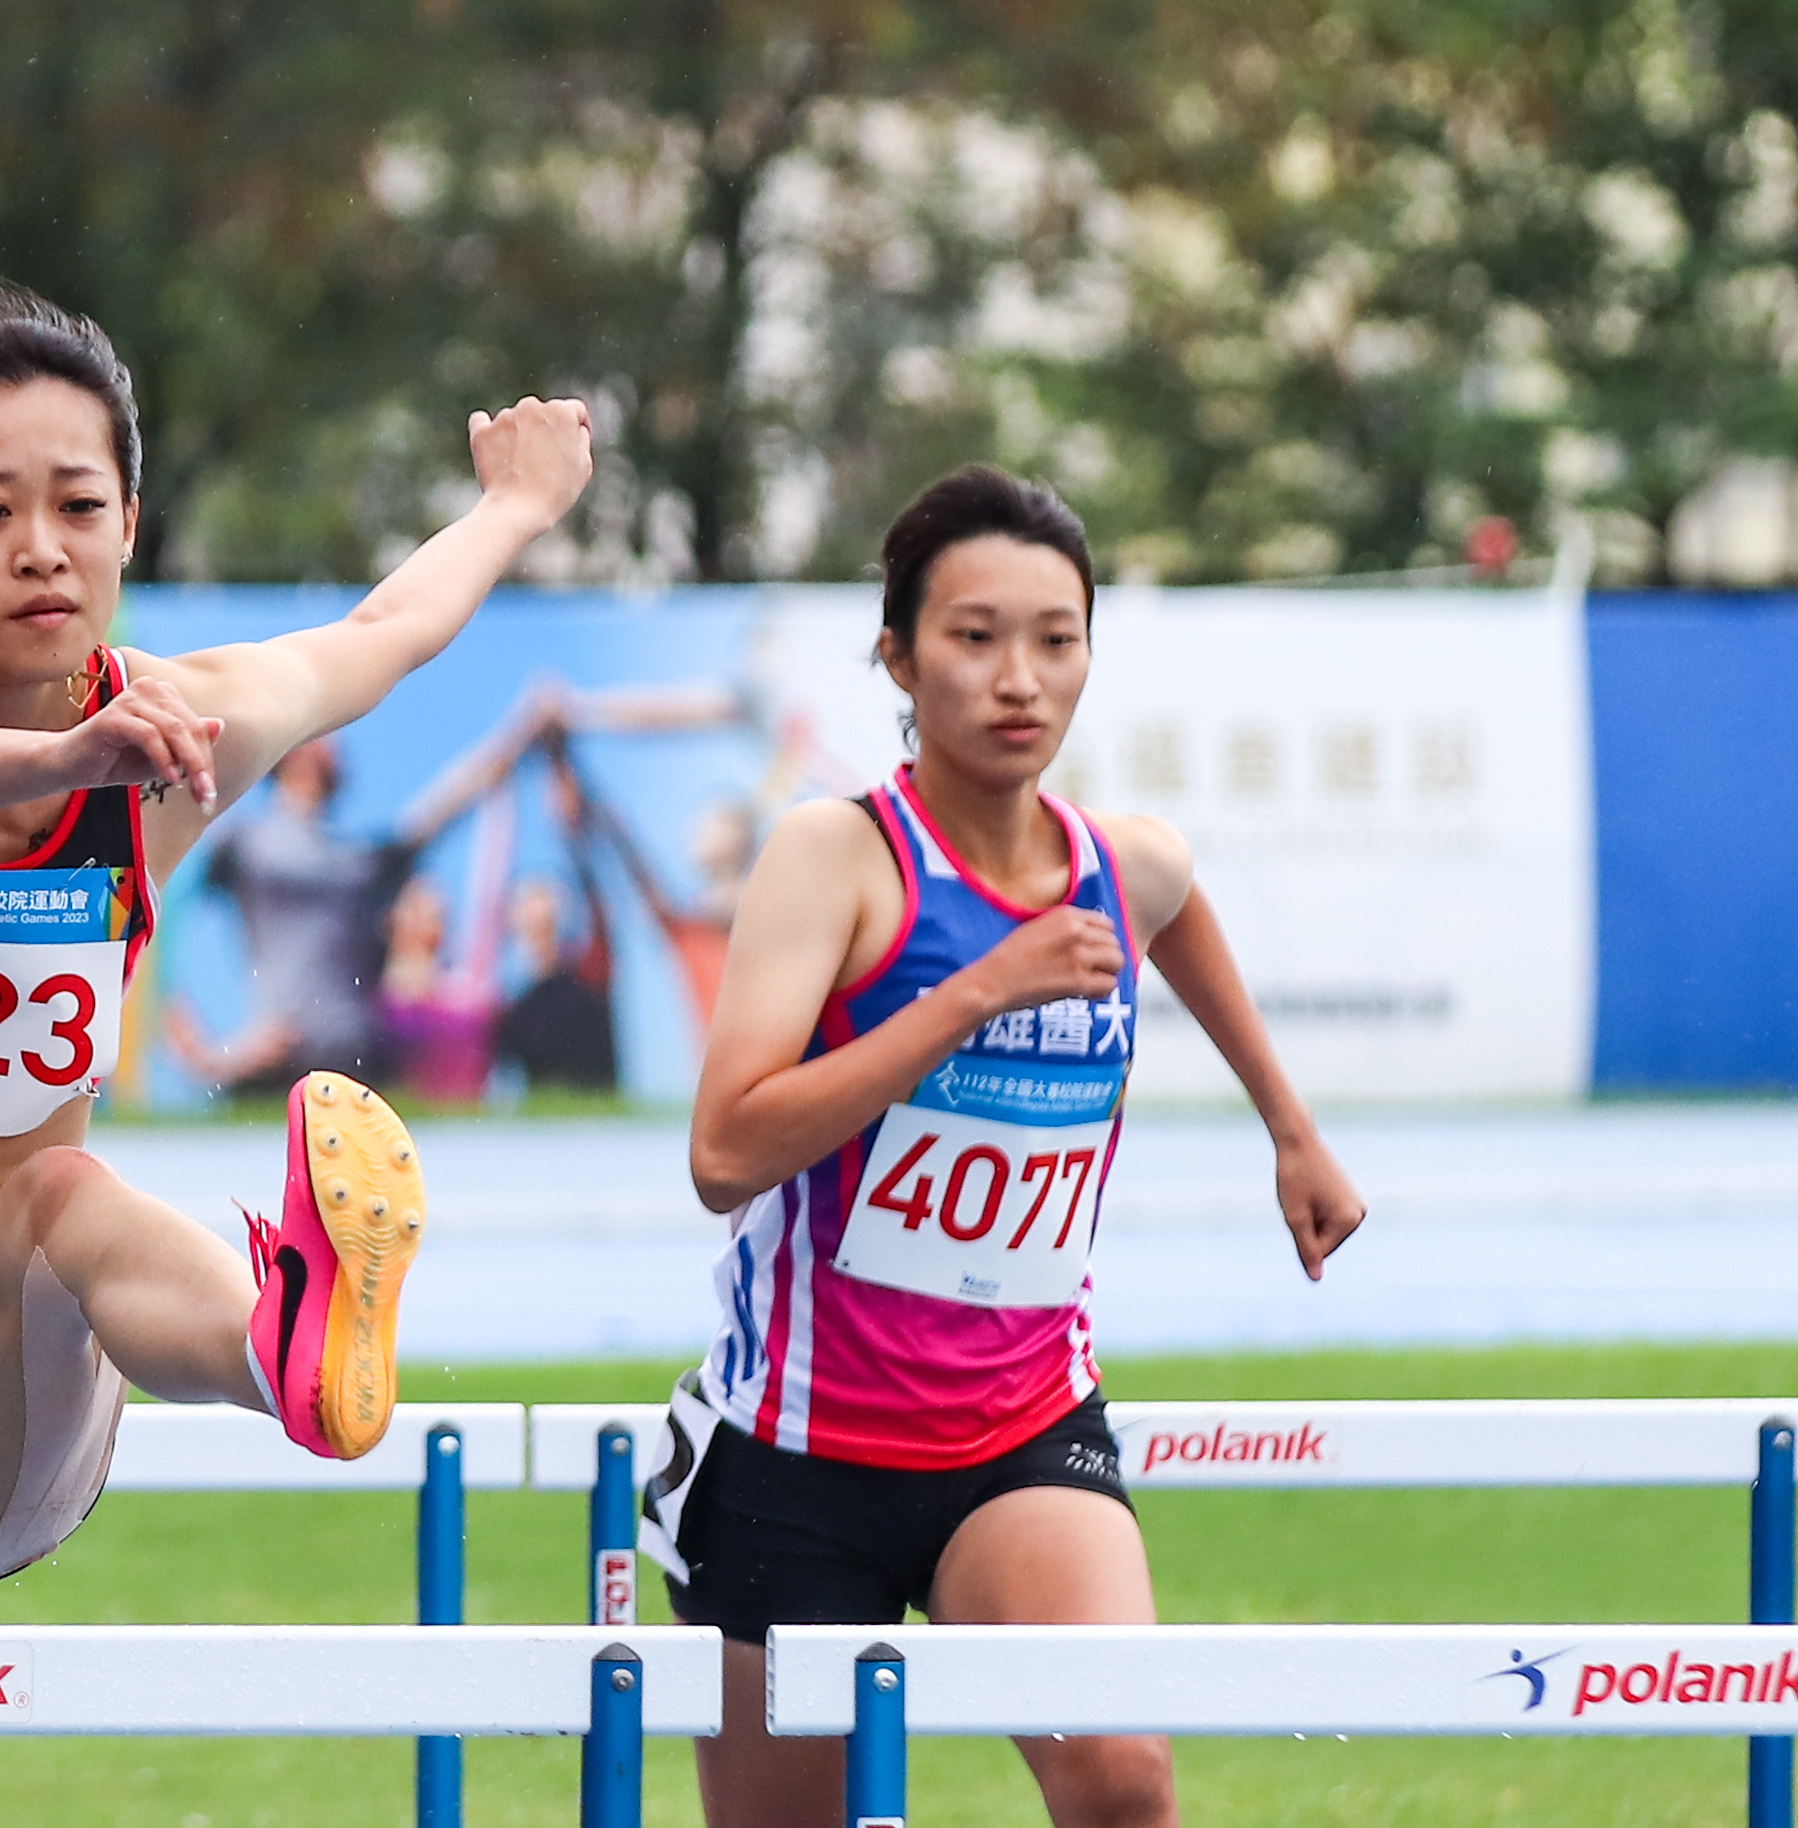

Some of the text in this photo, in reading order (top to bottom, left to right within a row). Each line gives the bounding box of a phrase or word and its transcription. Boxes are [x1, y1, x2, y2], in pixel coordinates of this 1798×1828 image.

[20, 912, 60, 924] Games
[62, 912, 90, 924] 2023
[916, 987, 1132, 1057] 雄醫大
[867, 1131, 1099, 1251] 4077
[1142, 1421, 1328, 1475] polanik
[1571, 1650, 1798, 1717] polanik
